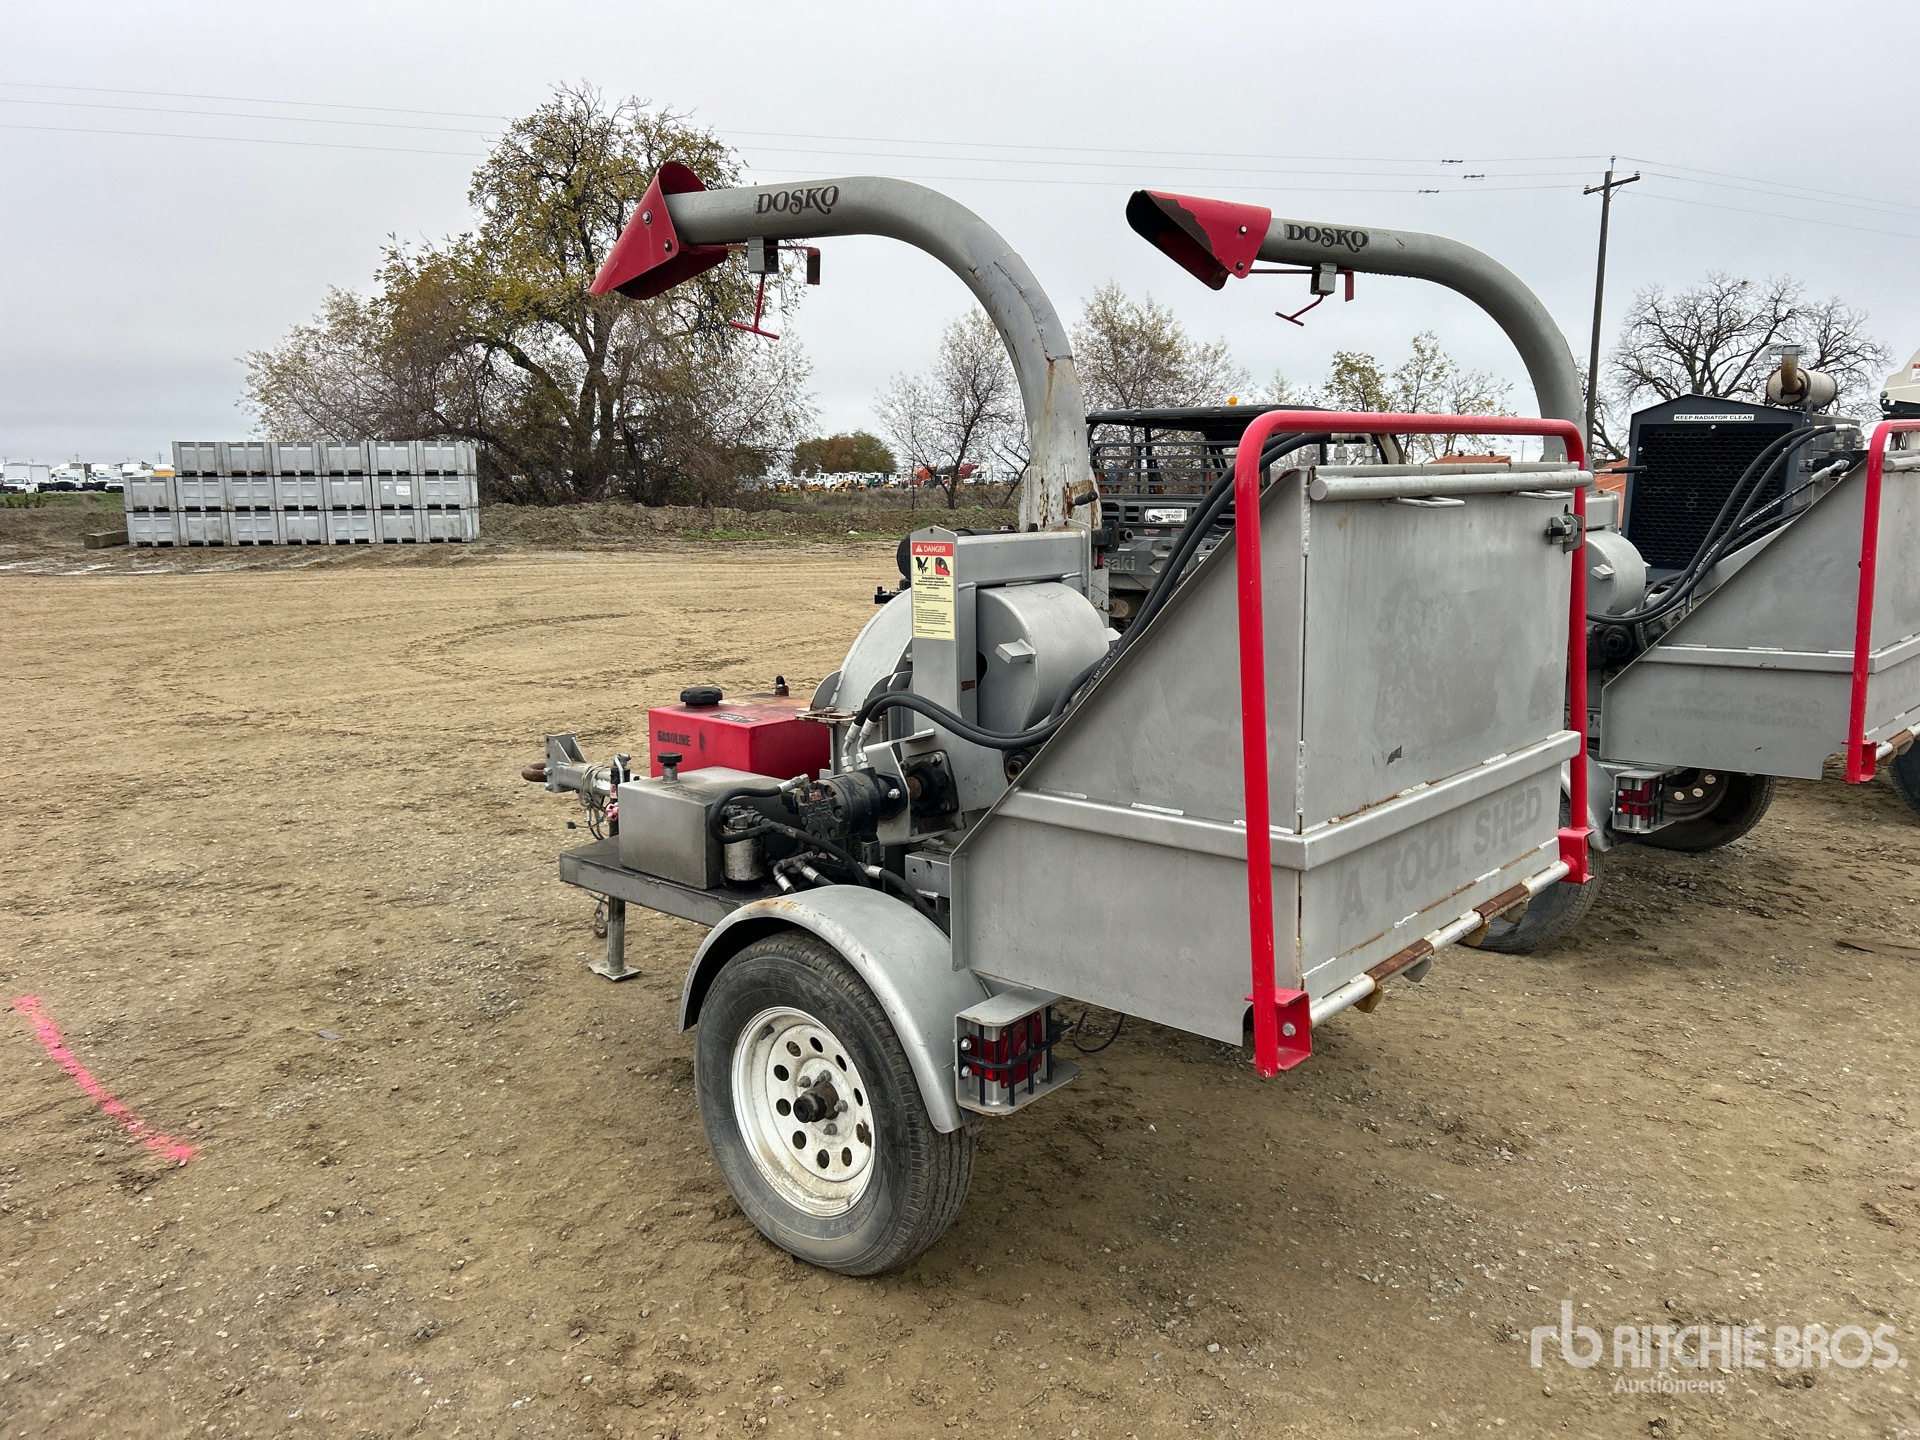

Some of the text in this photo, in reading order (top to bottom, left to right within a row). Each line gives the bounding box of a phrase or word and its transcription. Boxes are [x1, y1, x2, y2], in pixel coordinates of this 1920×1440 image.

[756, 185, 840, 215] DOSKO
[1286, 223, 1369, 253] DOSKO
[923, 545, 946, 553] DANGER
[1103, 555, 1135, 571] saki
[657, 730, 691, 747] GASOLINE
[1339, 786, 1542, 926] A TOOL SHED
